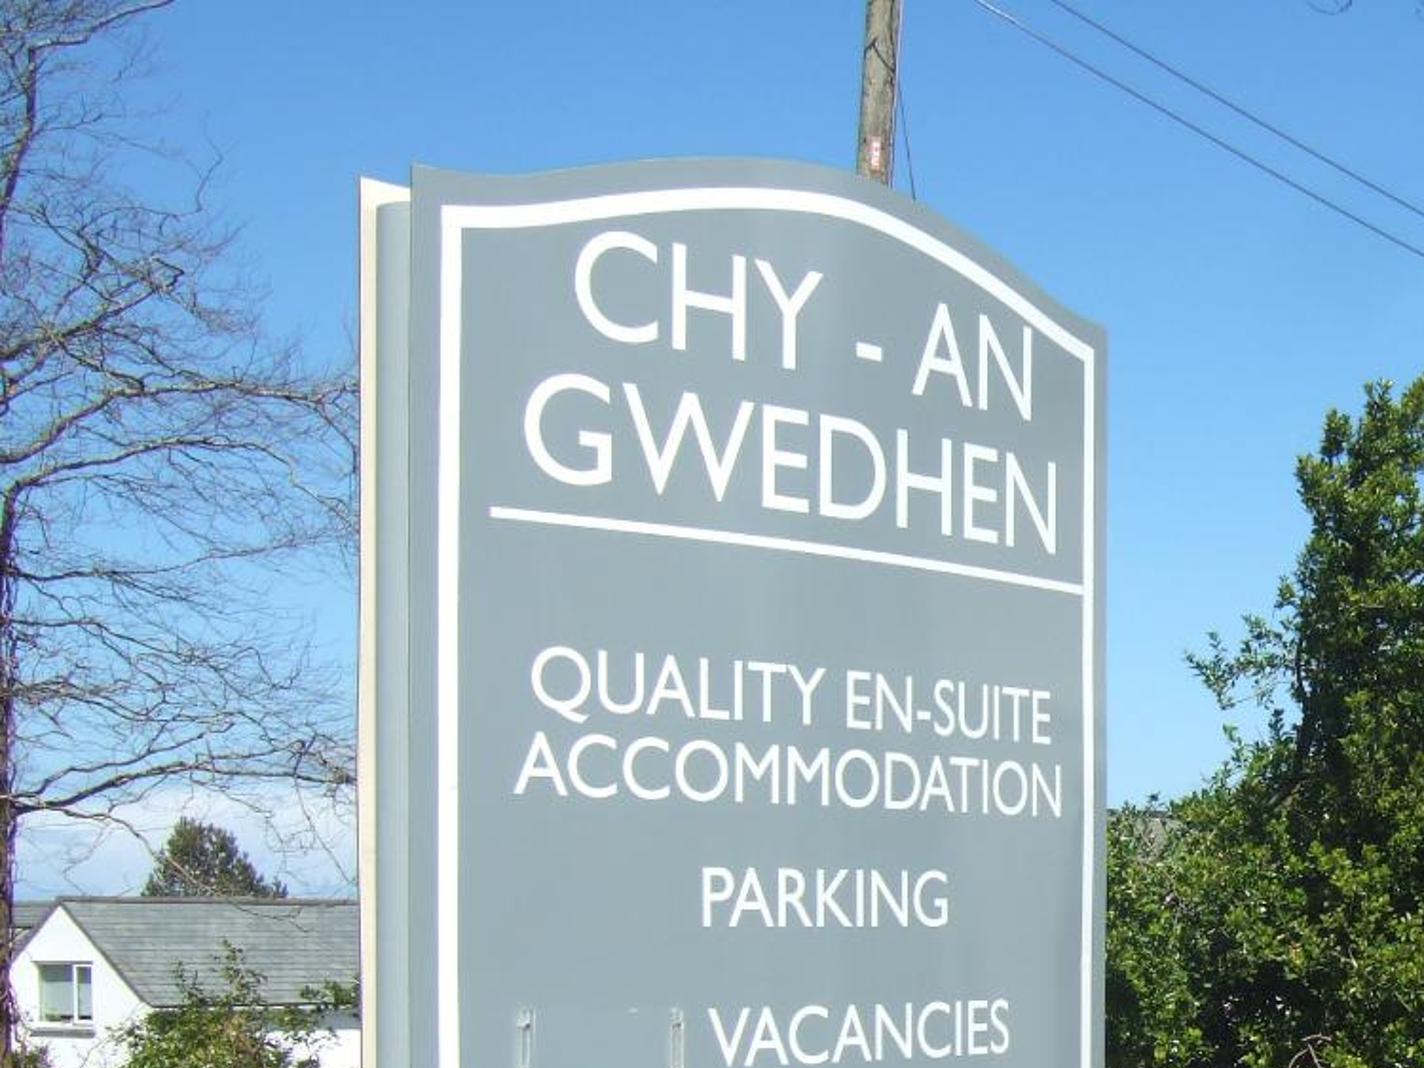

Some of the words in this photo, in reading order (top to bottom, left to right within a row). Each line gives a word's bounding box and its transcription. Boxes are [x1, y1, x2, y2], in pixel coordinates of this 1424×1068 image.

[573, 230, 824, 371] CHY
[912, 303, 1034, 421] AN
[523, 373, 1057, 555] GWEDHEN
[530, 645, 826, 725] QUALITY
[846, 670, 1052, 745] EN-SUITE
[513, 731, 1064, 819] ACCOMMODATION
[701, 866, 950, 928] PARKING
[707, 998, 1010, 1068] VACANCIES
